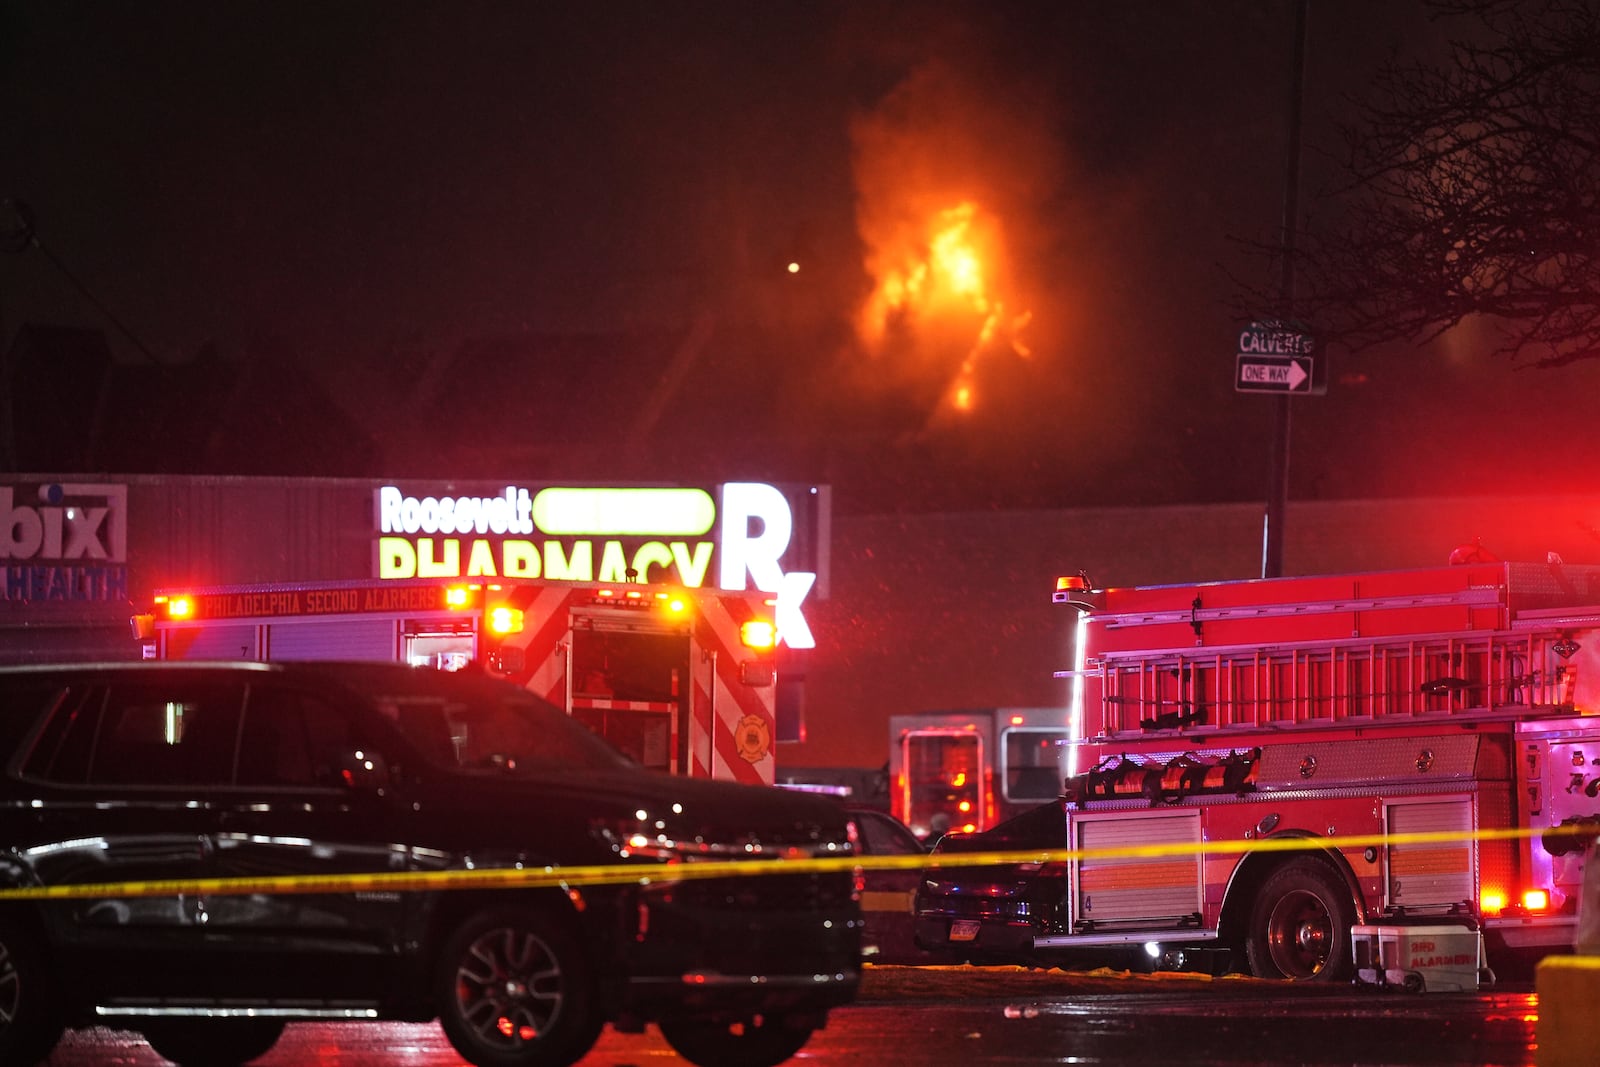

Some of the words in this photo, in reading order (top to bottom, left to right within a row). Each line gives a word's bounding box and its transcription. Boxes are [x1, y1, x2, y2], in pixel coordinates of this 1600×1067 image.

[1240, 331, 1302, 353] CALVERT
[1245, 366, 1265, 381] ONE
[1268, 366, 1289, 382] WAY
[380, 485, 534, 534] Roosevelt
[7, 566, 127, 601] HEALTH
[205, 591, 300, 617] PHILADELPHIA
[306, 589, 359, 613] SECOND
[364, 587, 436, 611] ALARMERS
[240, 646, 248, 657] 7
[1394, 880, 1402, 898] 2
[1085, 895, 1092, 912] 4
